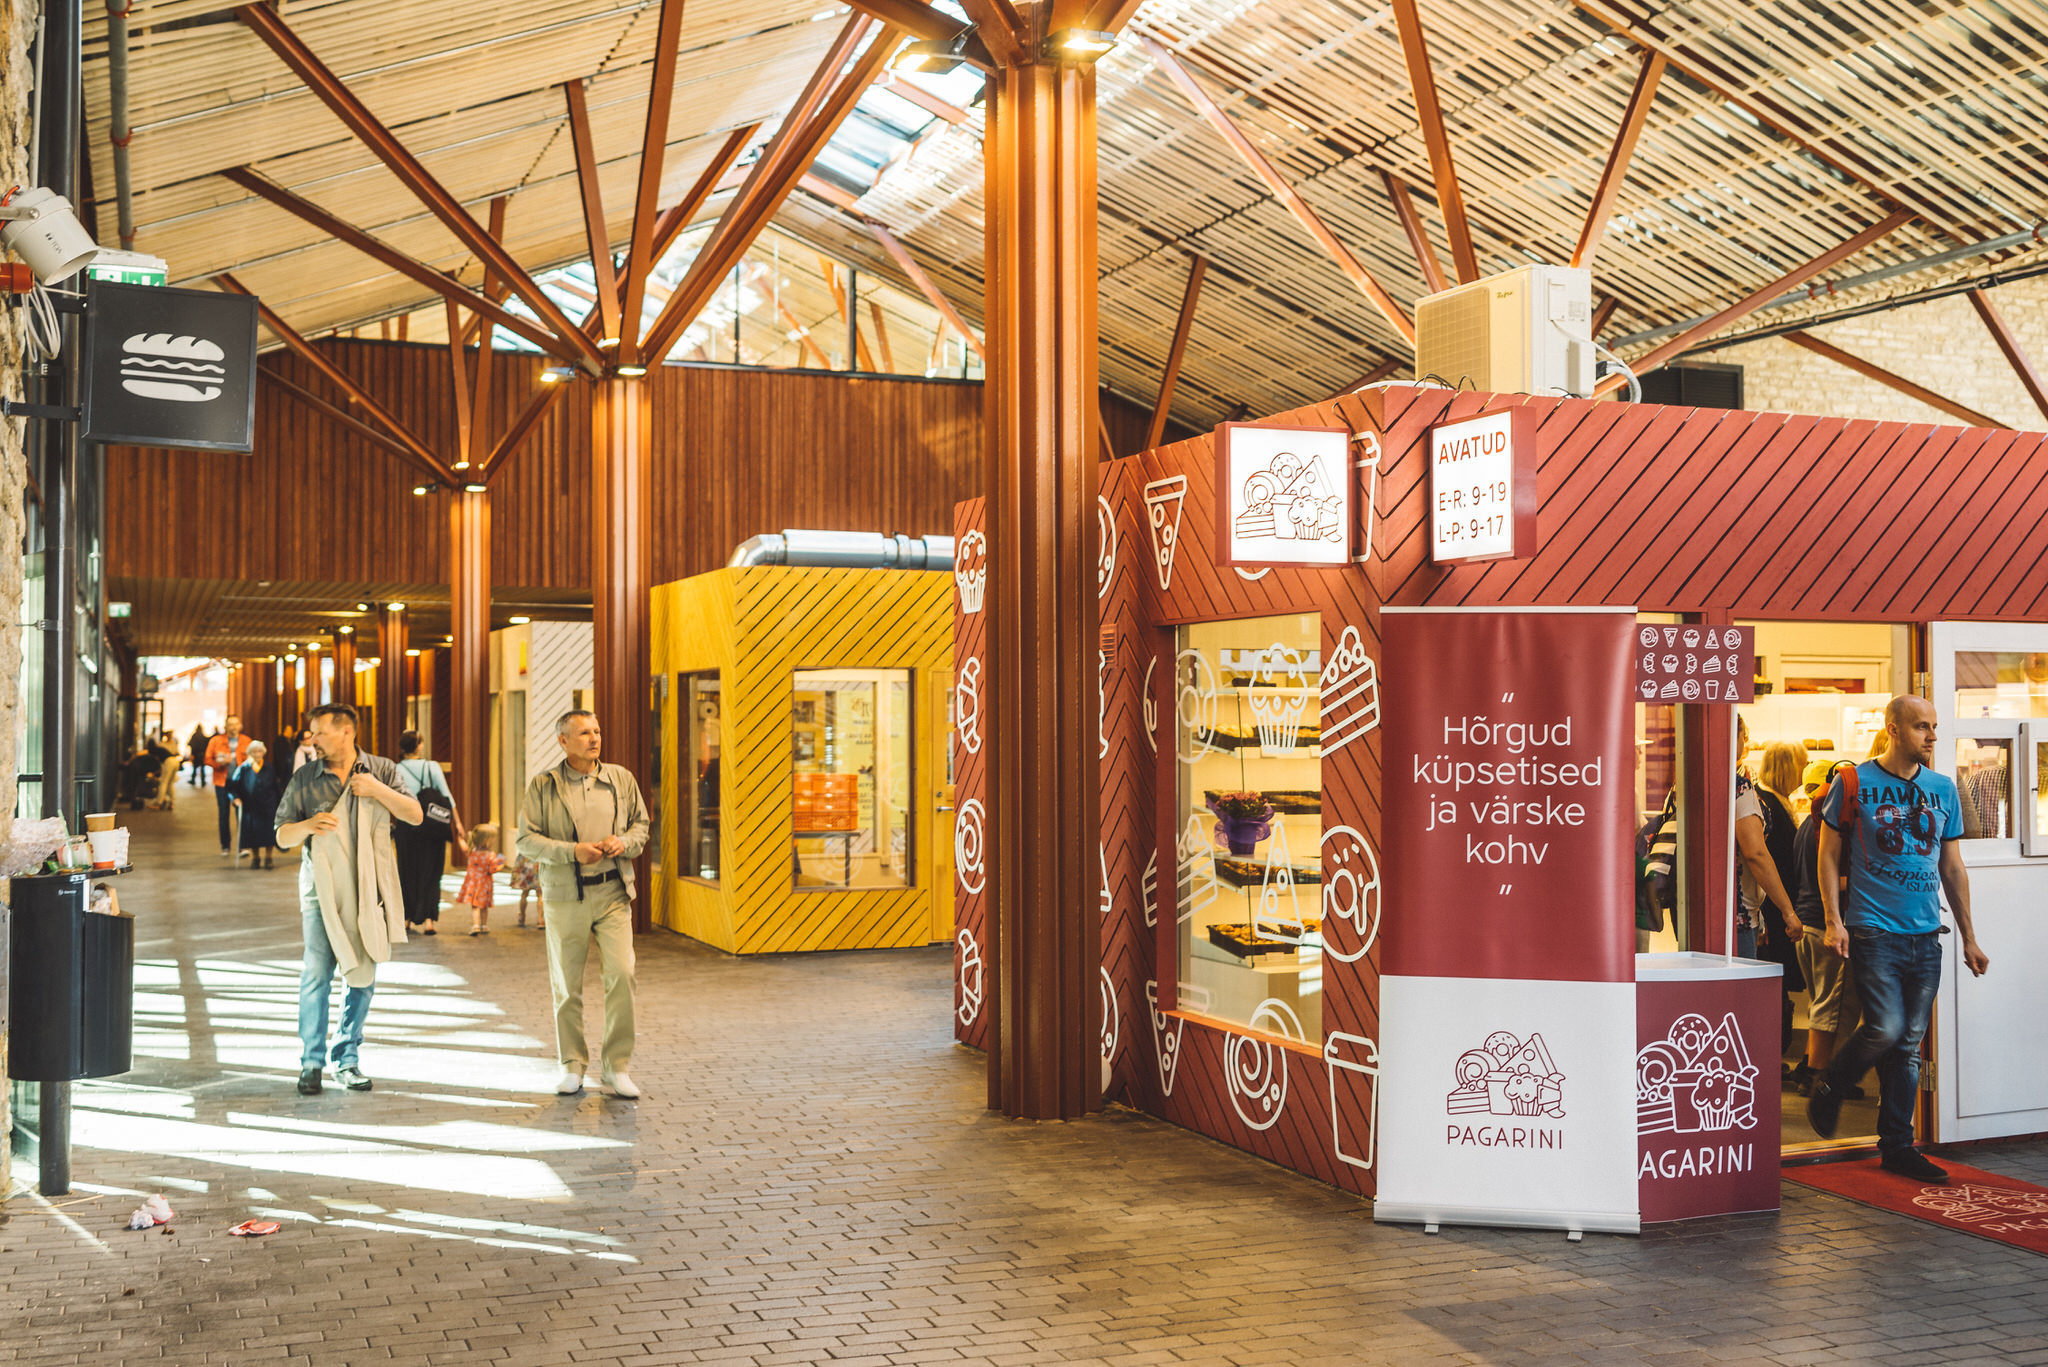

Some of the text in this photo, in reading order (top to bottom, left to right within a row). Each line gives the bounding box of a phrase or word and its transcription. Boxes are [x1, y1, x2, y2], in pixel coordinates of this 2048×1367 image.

[1439, 431, 1506, 464] AVATUD
[1439, 481, 1506, 511] E-R: 9-19
[1439, 515, 1504, 543] L-P: 9-17
[1444, 715, 1571, 754] Hõrgud
[1413, 754, 1602, 791] küpsetised
[1426, 794, 1586, 831] ja värske
[1861, 786, 1941, 809] HAWAII
[1466, 833, 1549, 865] kohv
[1447, 1124, 1562, 1150] PAGARINI
[1638, 1143, 1753, 1180] AGARINI
